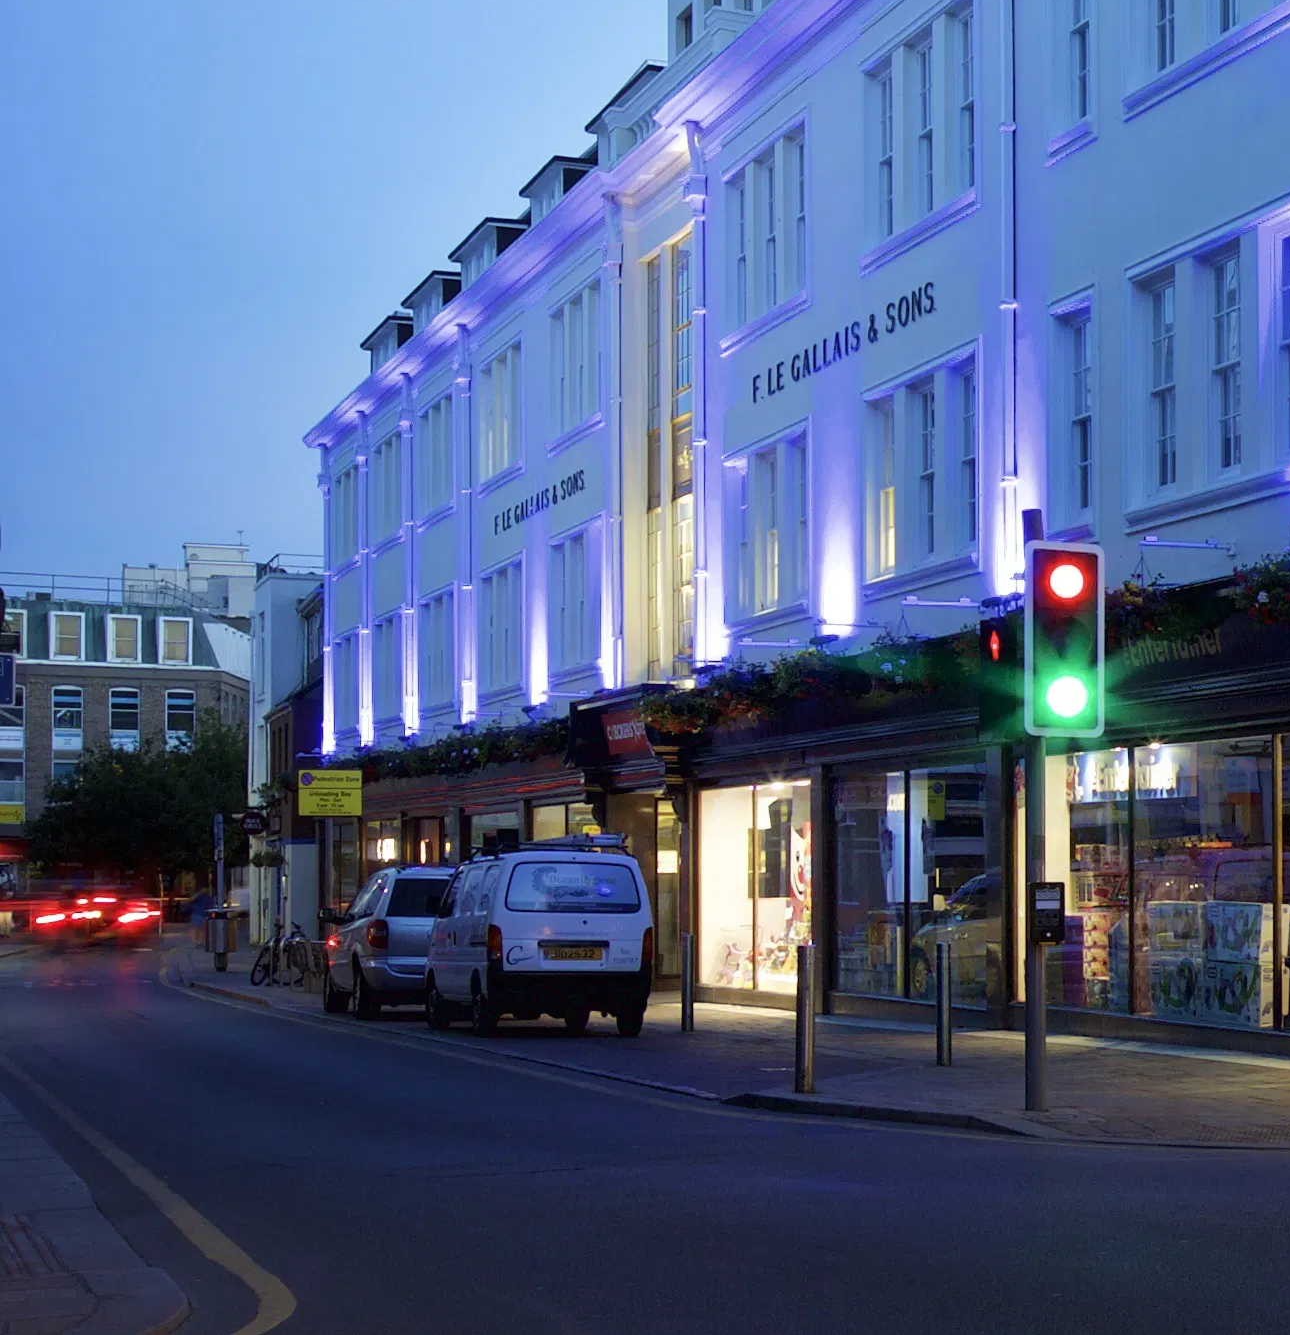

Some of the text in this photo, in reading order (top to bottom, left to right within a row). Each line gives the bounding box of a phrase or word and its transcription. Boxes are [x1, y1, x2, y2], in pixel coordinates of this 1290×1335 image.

[767, 360, 785, 397] LE
[790, 320, 861, 382] GALLAIS
[867, 313, 879, 344] &
[514, 488, 550, 525] GALLAIS
